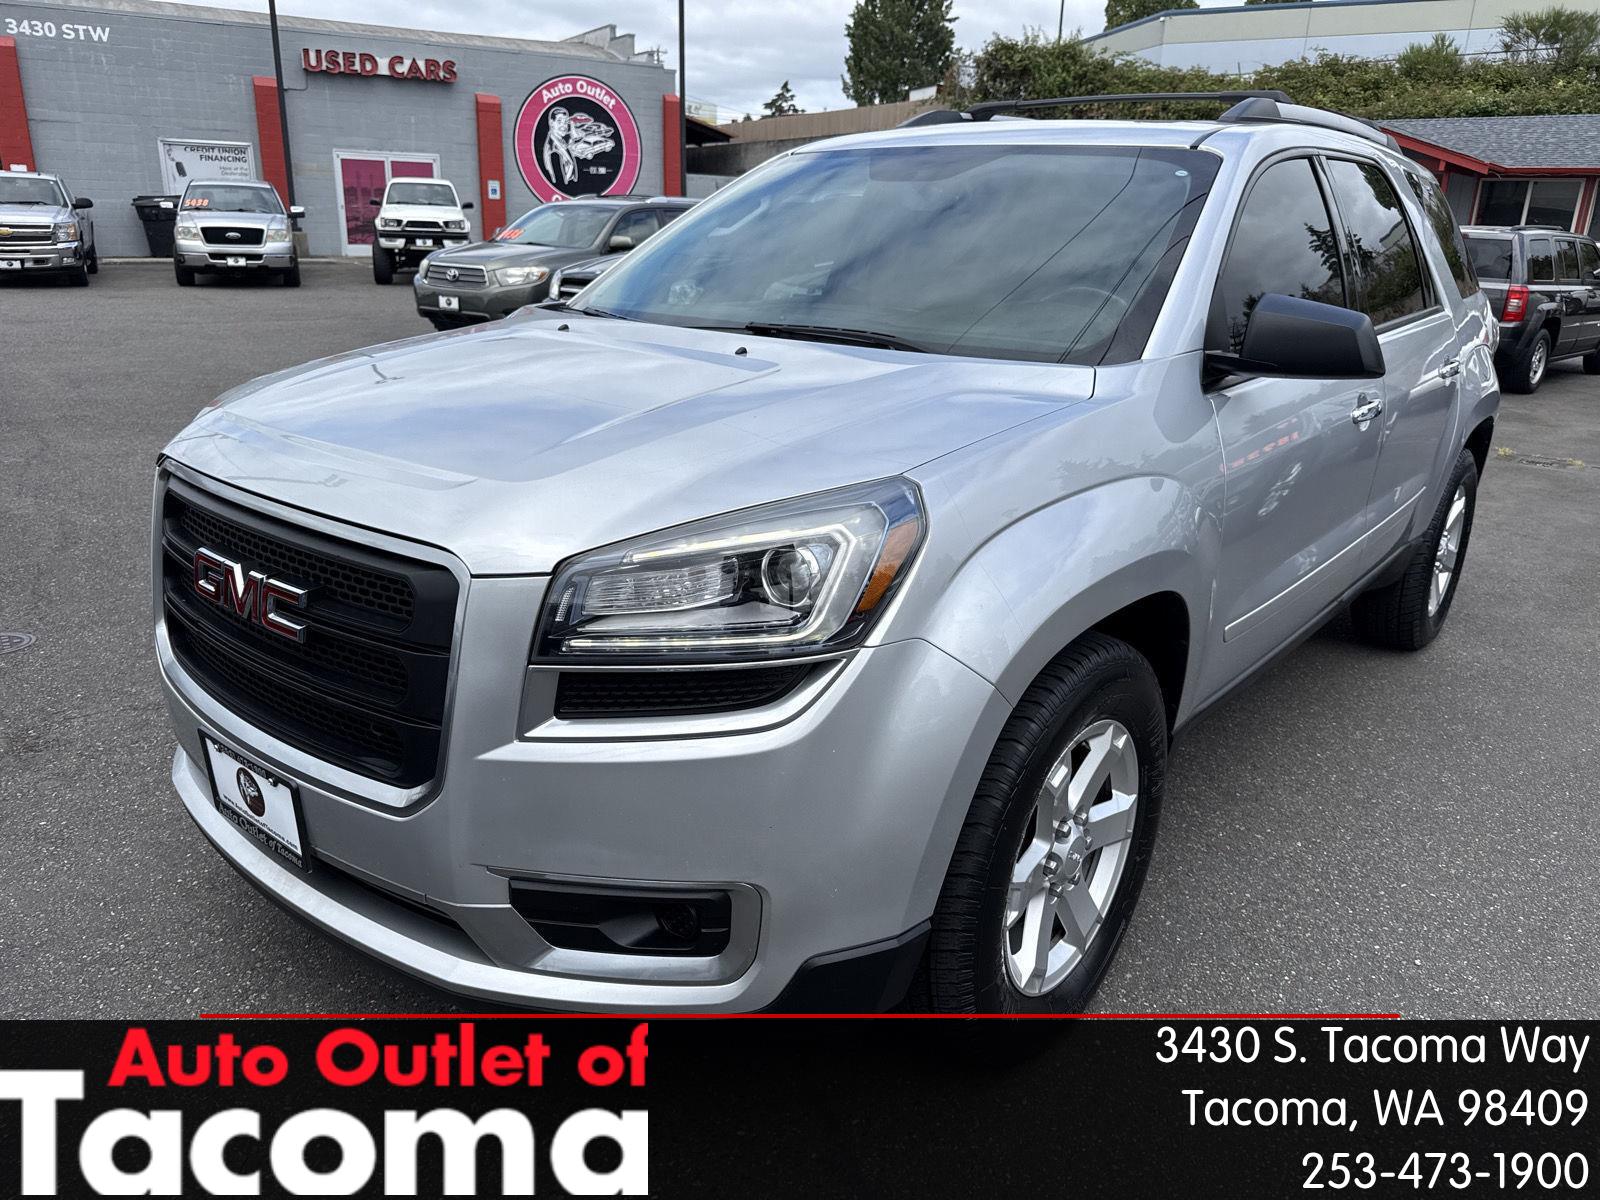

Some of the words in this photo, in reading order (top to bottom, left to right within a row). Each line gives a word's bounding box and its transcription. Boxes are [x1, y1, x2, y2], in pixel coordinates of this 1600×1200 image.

[4, 18, 56, 37] 3430
[61, 23, 110, 42] STW
[302, 48, 379, 76] USED
[388, 56, 458, 83] CARS
[541, 82, 573, 103] Auto
[576, 81, 617, 110] Outlet
[199, 154, 248, 163] FINANCING
[194, 547, 308, 643] GMC
